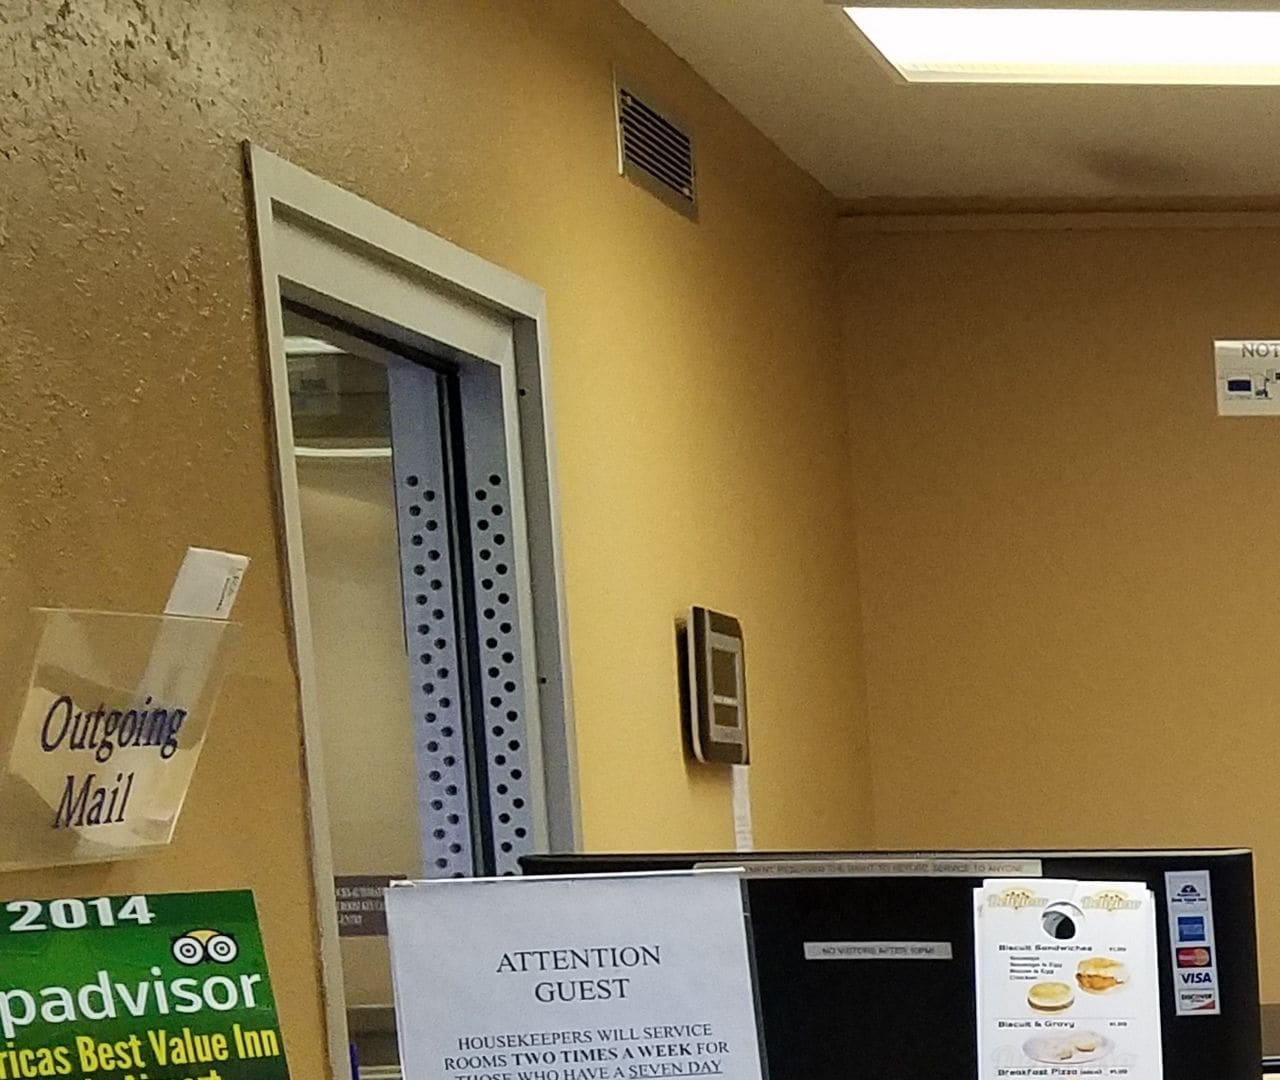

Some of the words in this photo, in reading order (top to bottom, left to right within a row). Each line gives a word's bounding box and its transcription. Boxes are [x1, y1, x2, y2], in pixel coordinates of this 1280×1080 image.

[41, 696, 187, 762] Outgoing
[51, 773, 134, 829] Mail
[974, 864, 986, 872] TO
[6, 895, 156, 932] 2014
[496, 945, 661, 973] ATTENTION
[534, 978, 631, 1003] GUEST
[1181, 972, 1212, 984] VISA
[0, 966, 261, 1039] padvisor
[458, 1031, 593, 1051] HOUSEKEEPERS
[597, 1028, 642, 1043] WILL
[643, 1023, 713, 1040] SERVICE
[1045, 1021, 1075, 1030] Gravy
[75, 1035, 146, 1072] Best
[148, 1028, 229, 1066] Value
[233, 1023, 280, 1059] Inn
[444, 1054, 508, 1071] ROOMS
[511, 1050, 556, 1066] TWO
[560, 1048, 618, 1064] TIMES
[621, 1046, 635, 1060] A
[638, 1043, 693, 1058] WEEK
[696, 1041, 730, 1055] FOR
[613, 1066, 626, 1080] A
[628, 1062, 684, 1080] SEVEN
[688, 1059, 723, 1075] DAY
[1052, 1068, 1078, 1076] Pizza
